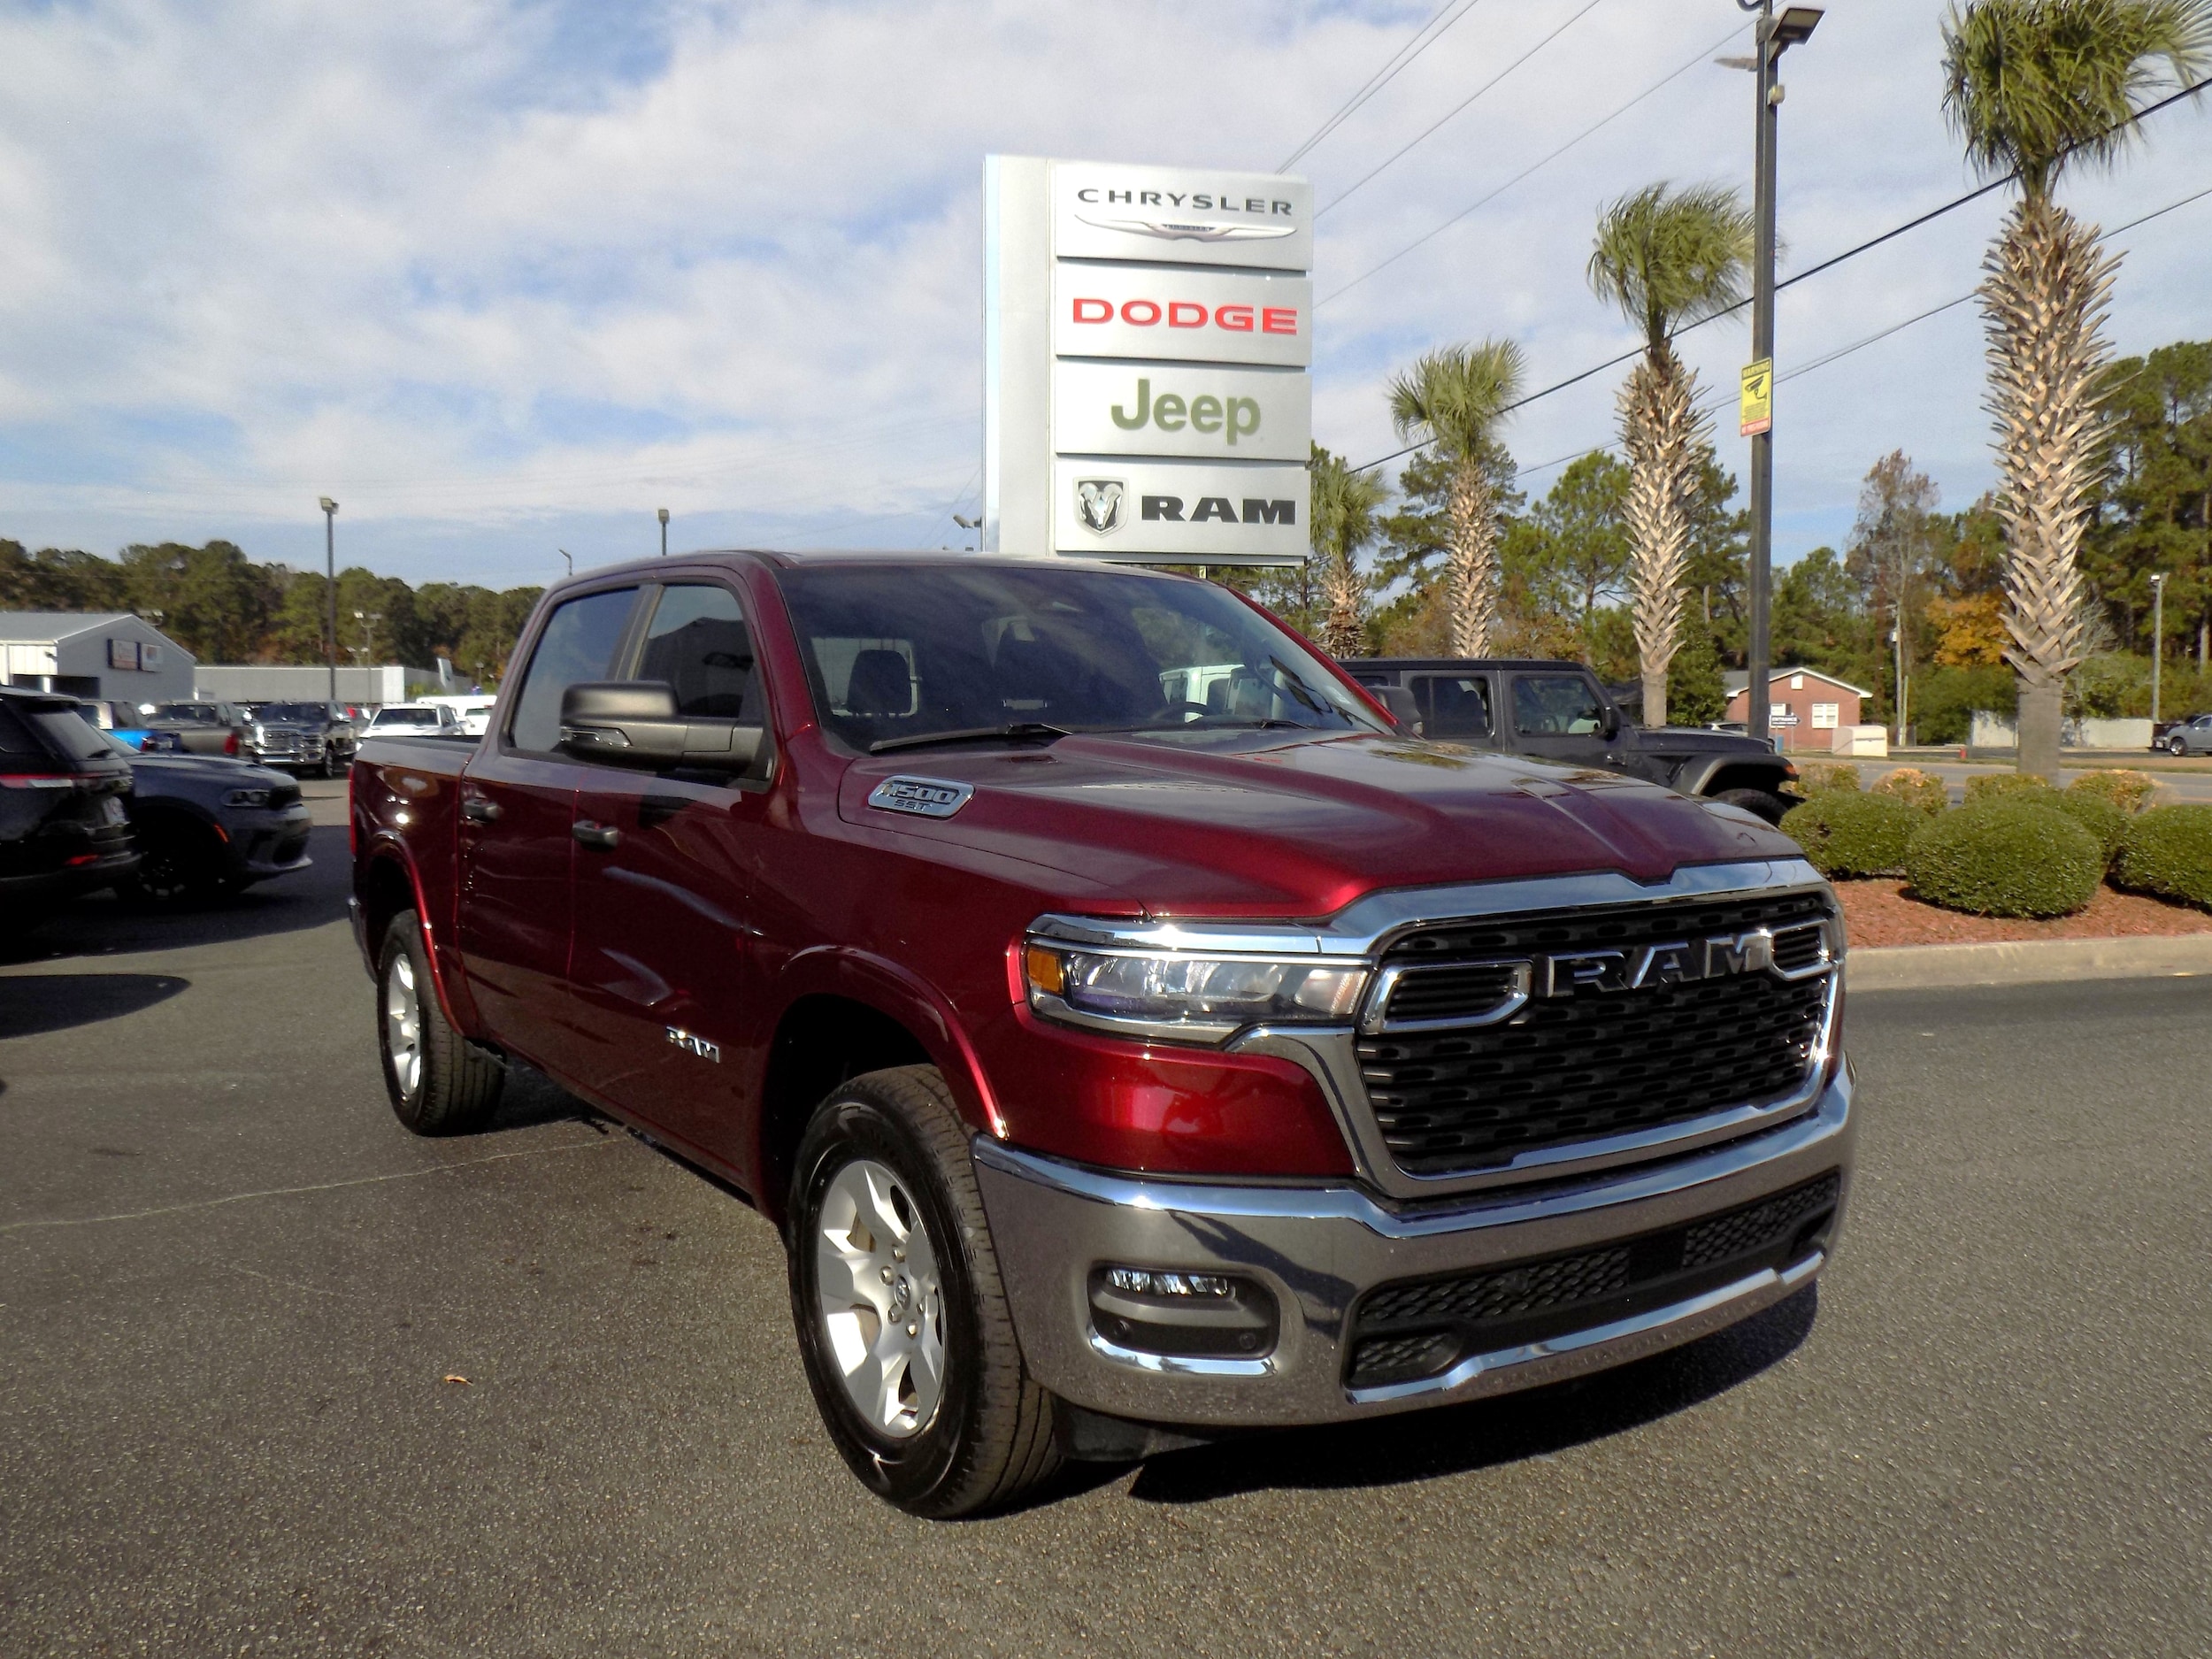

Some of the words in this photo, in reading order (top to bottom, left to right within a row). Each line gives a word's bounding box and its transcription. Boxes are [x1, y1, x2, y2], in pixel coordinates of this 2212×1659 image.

[1077, 188, 1293, 217] CHRYSLER
[1072, 298, 1298, 335] DODGE
[1110, 378, 1262, 446] Jeep
[1141, 495, 1296, 526] RAM
[885, 782, 958, 804] 1500
[894, 799, 930, 811] SST
[1546, 929, 1771, 999] RAM
